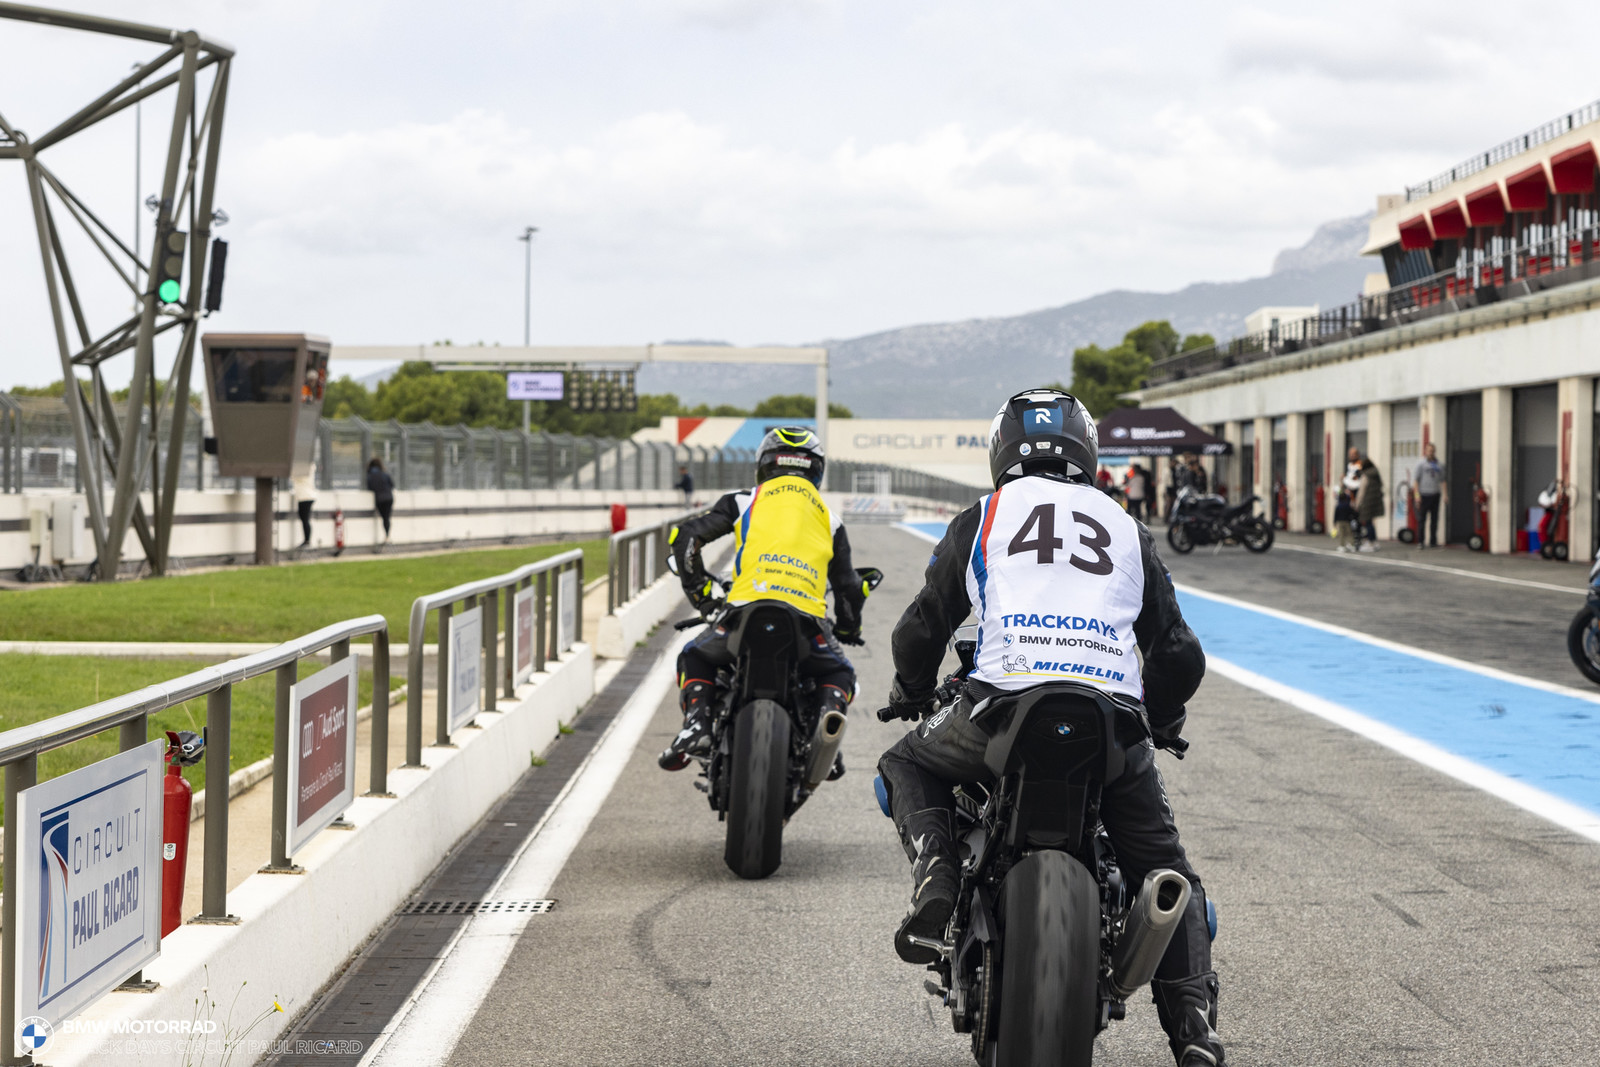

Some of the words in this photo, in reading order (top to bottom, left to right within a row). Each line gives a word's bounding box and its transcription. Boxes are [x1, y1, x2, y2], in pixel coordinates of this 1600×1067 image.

[853, 433, 946, 449] CIRCUIT
[1008, 503, 1114, 575] 43
[1001, 614, 1119, 641] TRACKDAYS
[1019, 635, 1052, 645] BMW
[1055, 638, 1123, 657] MOTORRAD
[1033, 661, 1125, 682] MICHELIN
[322, 709, 332, 739] Audi
[332, 705, 345, 738] Sport
[73, 808, 140, 875] CIRCUIT
[73, 889, 99, 949] PAUL
[103, 866, 139, 930] RICARD
